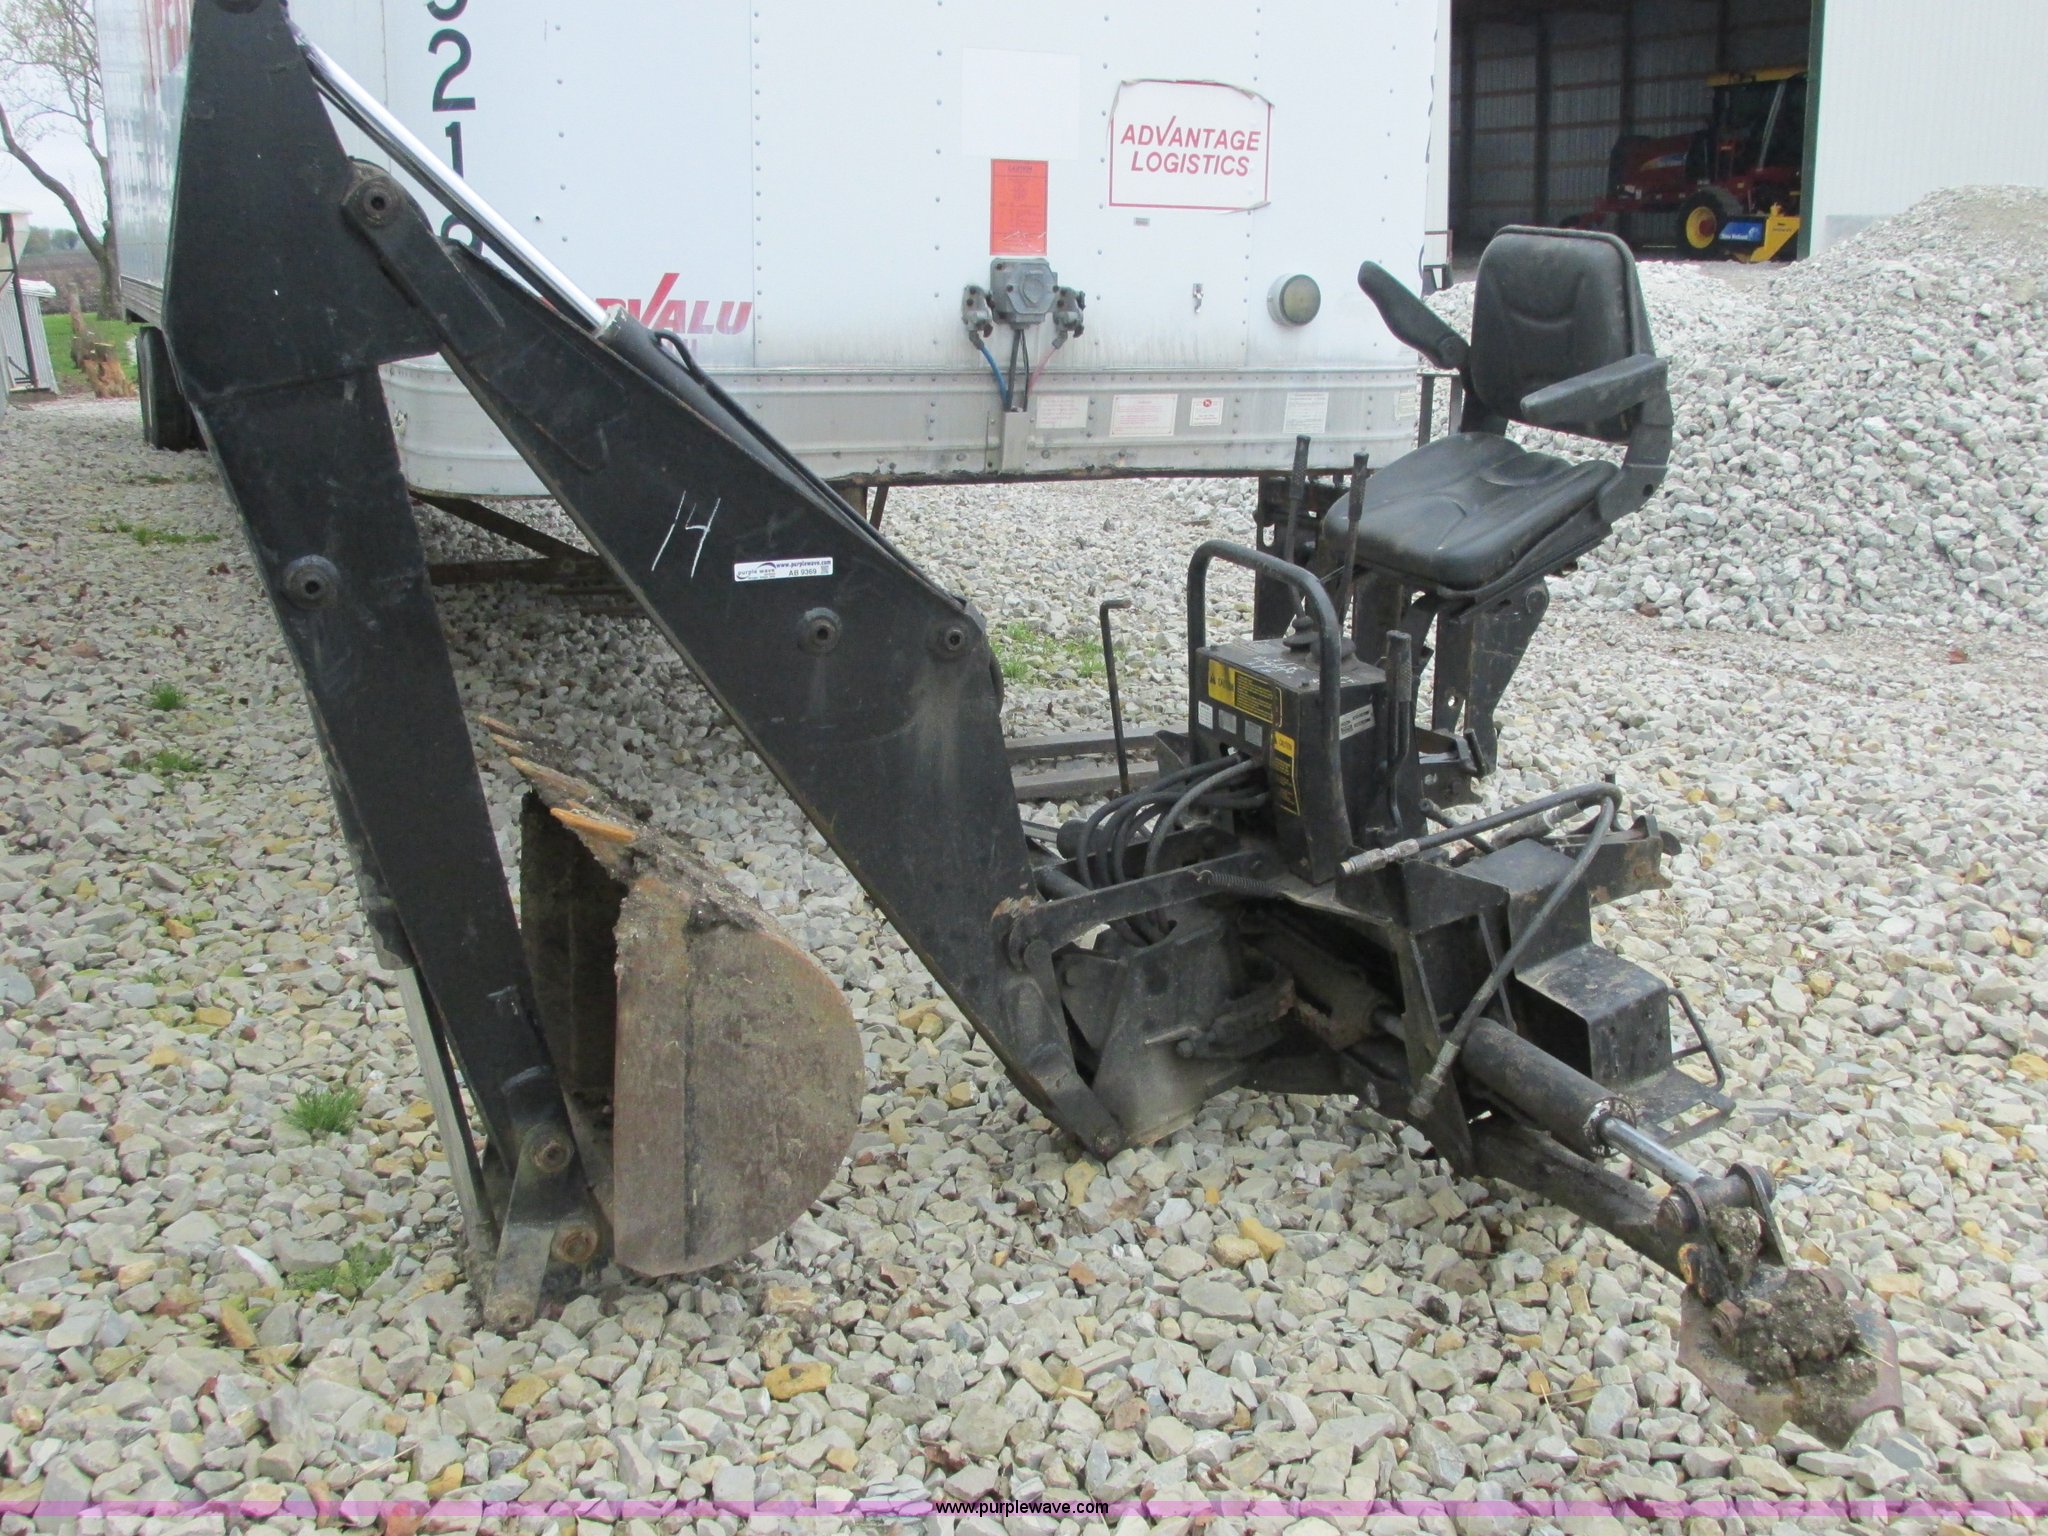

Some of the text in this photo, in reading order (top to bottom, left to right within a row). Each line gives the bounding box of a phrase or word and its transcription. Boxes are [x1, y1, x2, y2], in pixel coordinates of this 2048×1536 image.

[1121, 116, 1262, 152] ADVANTAGE
[1131, 151, 1251, 177] LOGISTICS
[651, 490, 721, 579] 14
[737, 568, 757, 577] purple
[775, 559, 832, 569] www.purplewave.com
